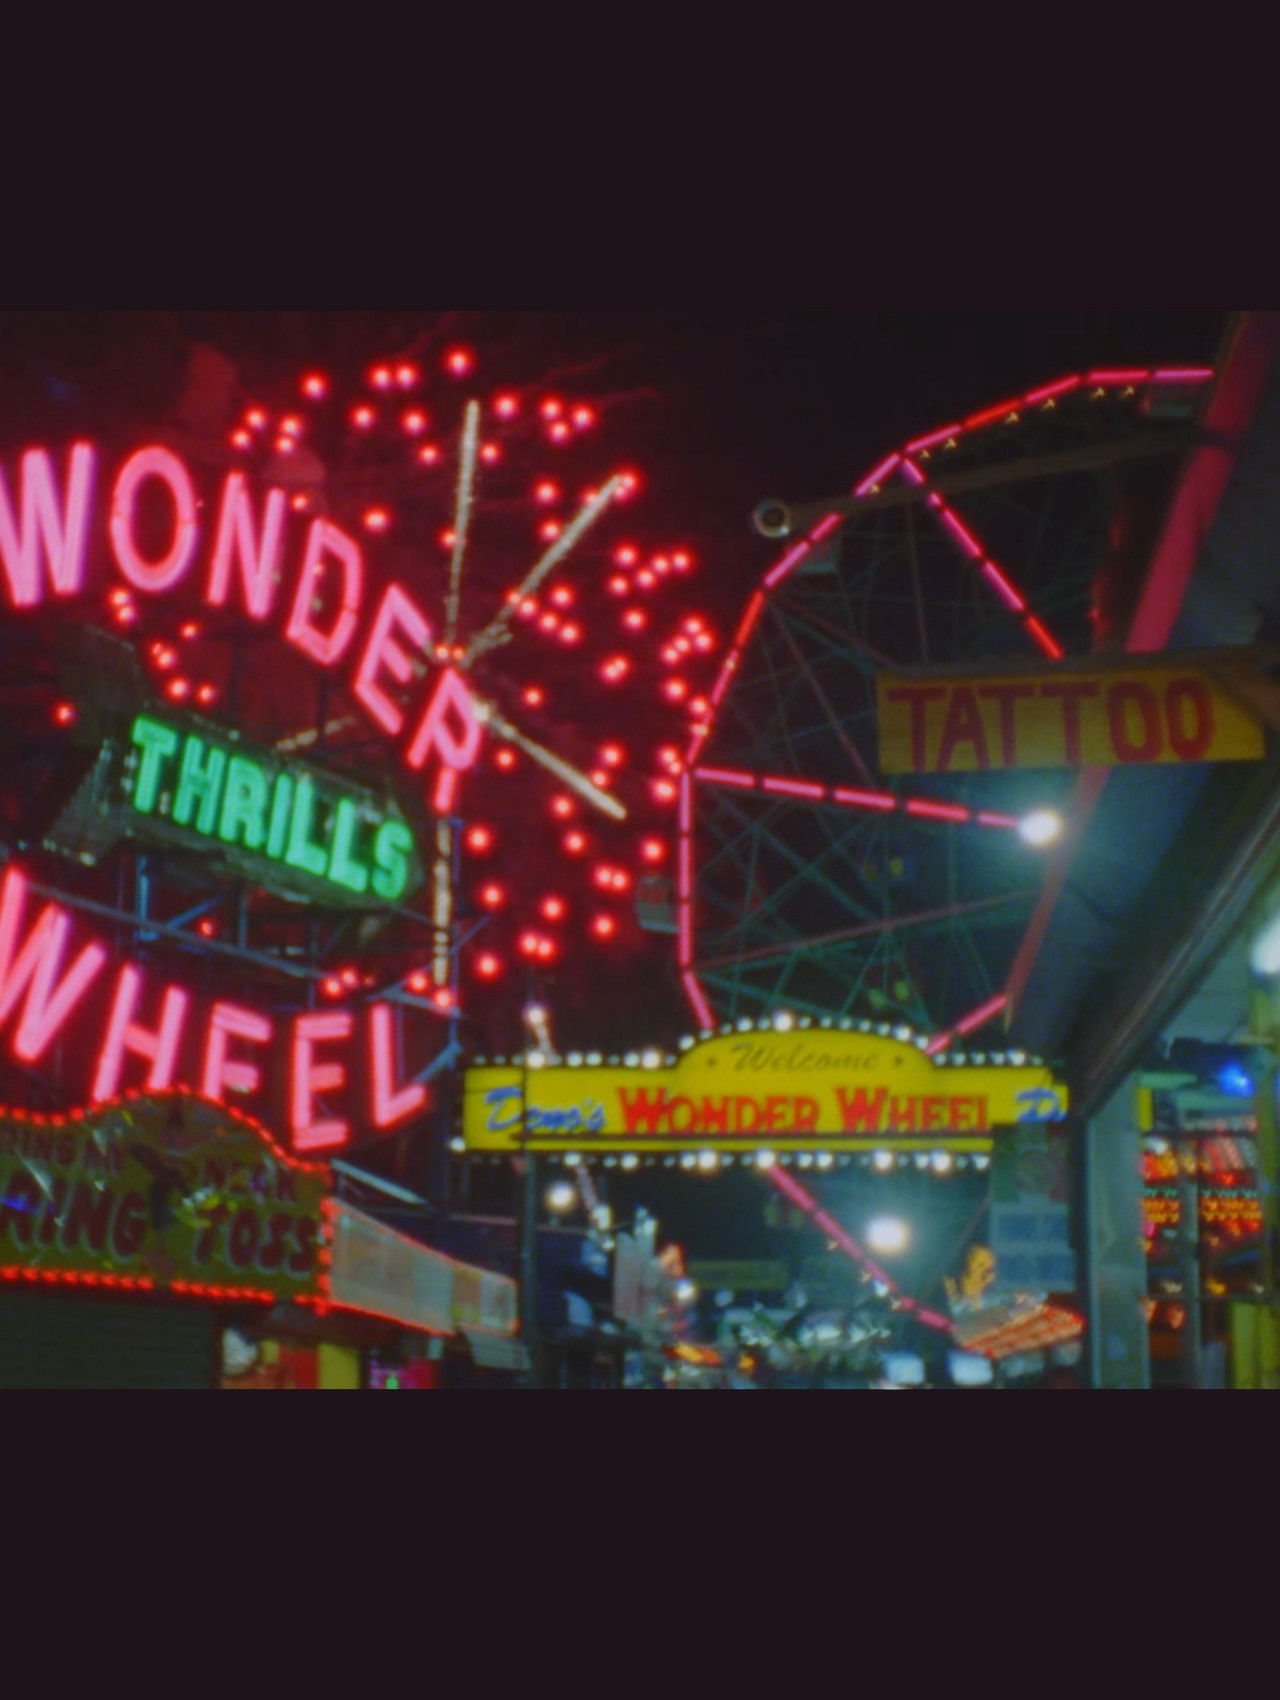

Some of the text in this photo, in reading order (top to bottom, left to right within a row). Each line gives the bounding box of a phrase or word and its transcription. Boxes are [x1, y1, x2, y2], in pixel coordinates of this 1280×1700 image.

[0, 440, 484, 814] WONDER
[885, 680, 1215, 773] TATTOO
[132, 716, 414, 899] THRILLS
[0, 860, 428, 1151] WHEEL
[730, 1042, 880, 1072] Welcome
[617, 1086, 821, 1135] WONDER
